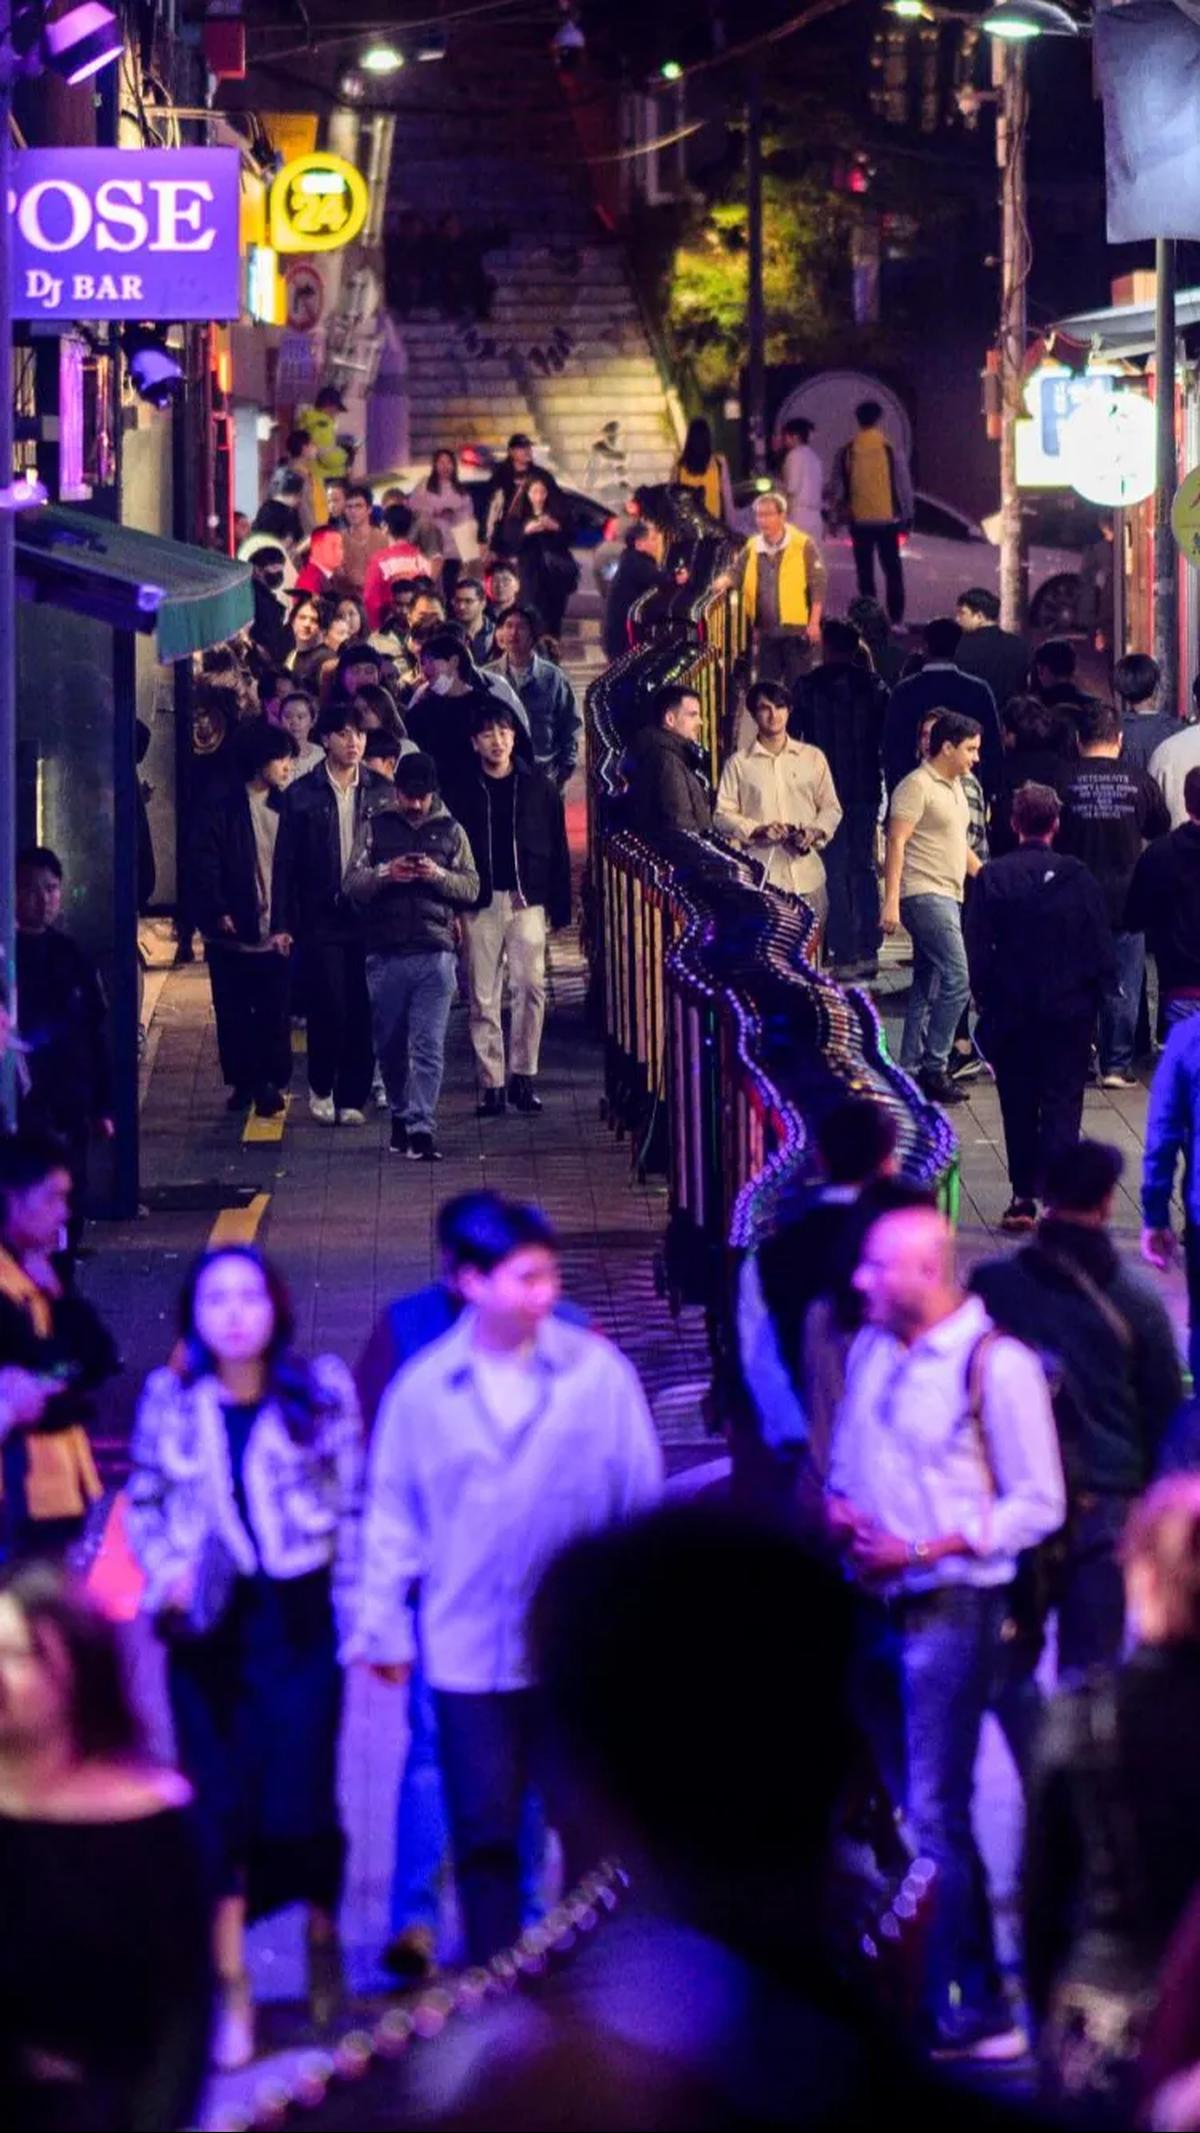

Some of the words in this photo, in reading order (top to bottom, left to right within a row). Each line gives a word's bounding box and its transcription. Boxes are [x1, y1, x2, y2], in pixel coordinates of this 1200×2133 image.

[7, 179, 217, 253] OSE
[290, 190, 350, 233] 24
[72, 274, 144, 301] BAR
